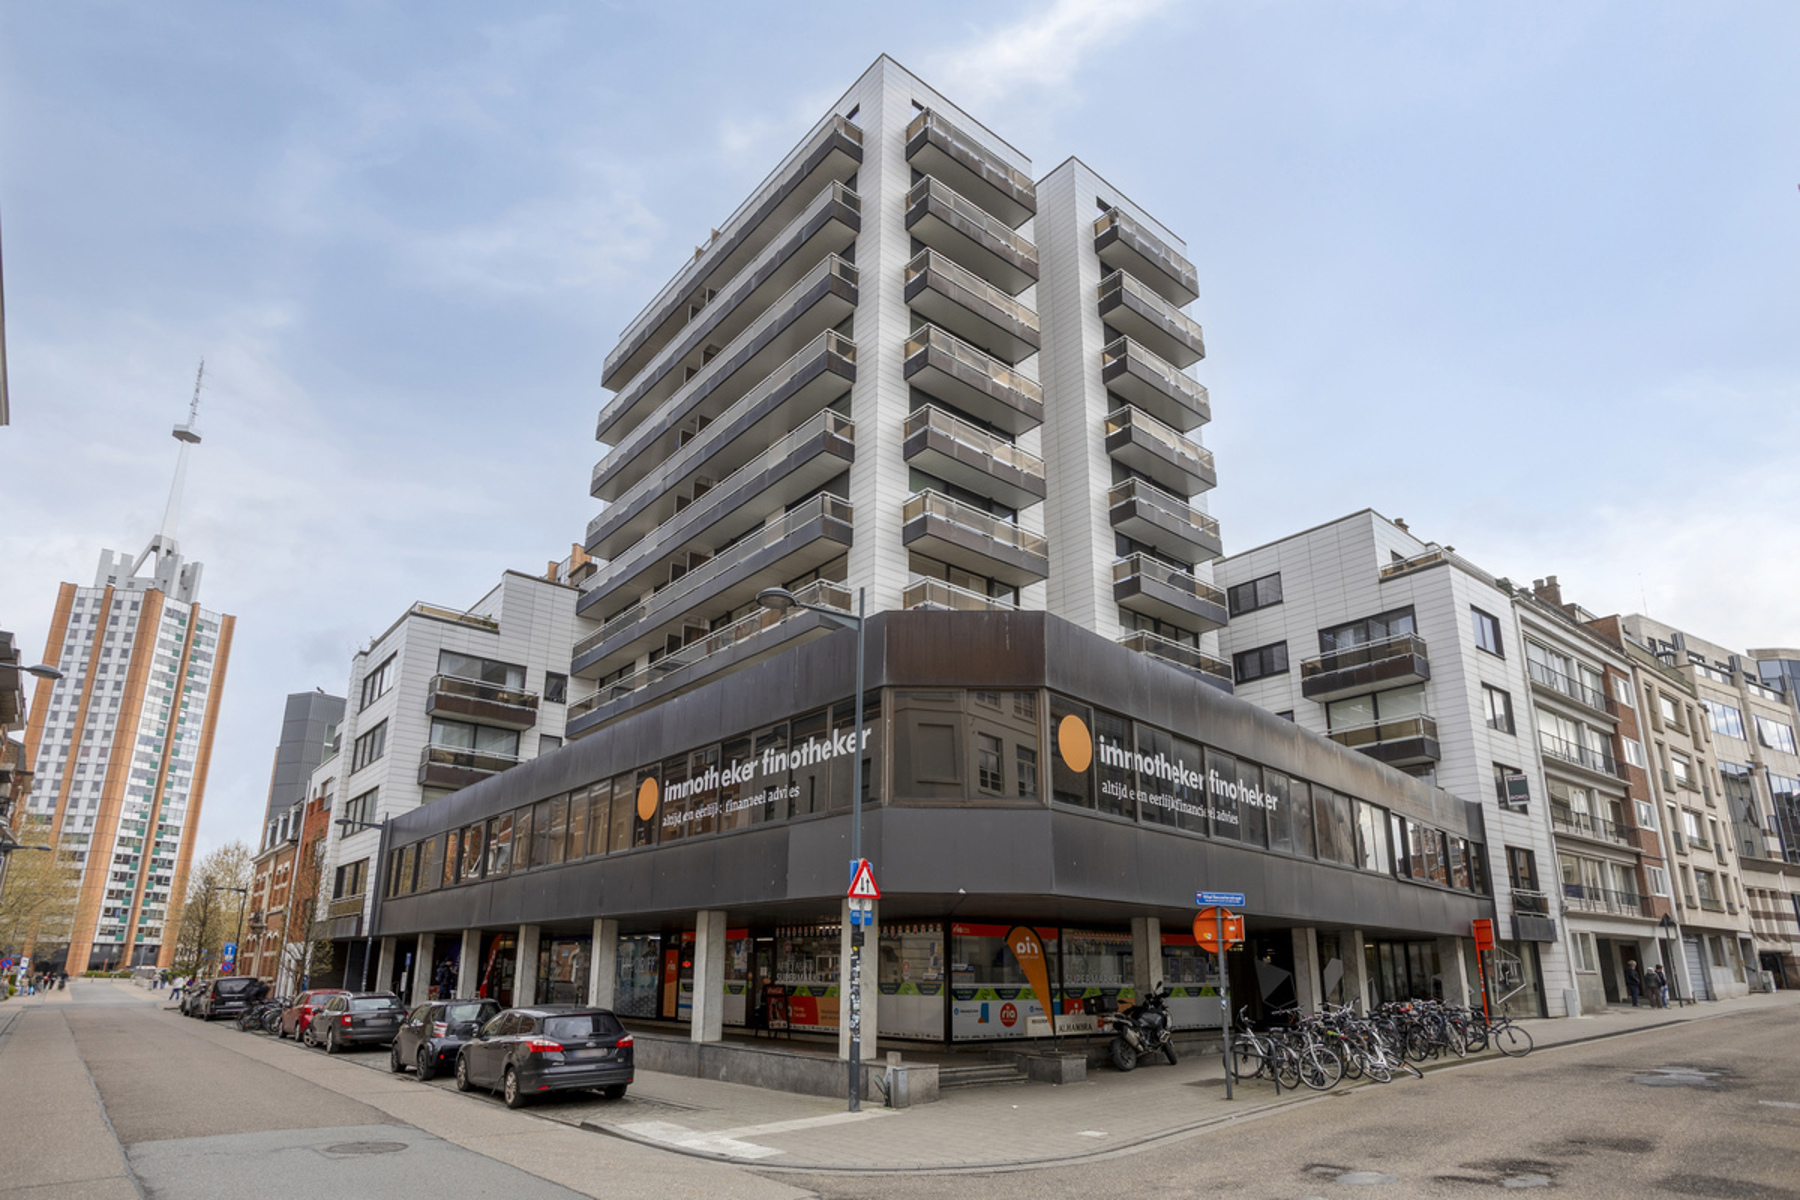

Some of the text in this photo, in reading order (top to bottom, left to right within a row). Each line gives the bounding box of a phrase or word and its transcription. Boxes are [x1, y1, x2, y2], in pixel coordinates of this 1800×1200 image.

[663, 728, 872, 803] immotheker finotheker
[1099, 735, 1278, 811] immotheker finoheker
[768, 784, 800, 803] advies
[1102, 780, 1128, 800] altijd
